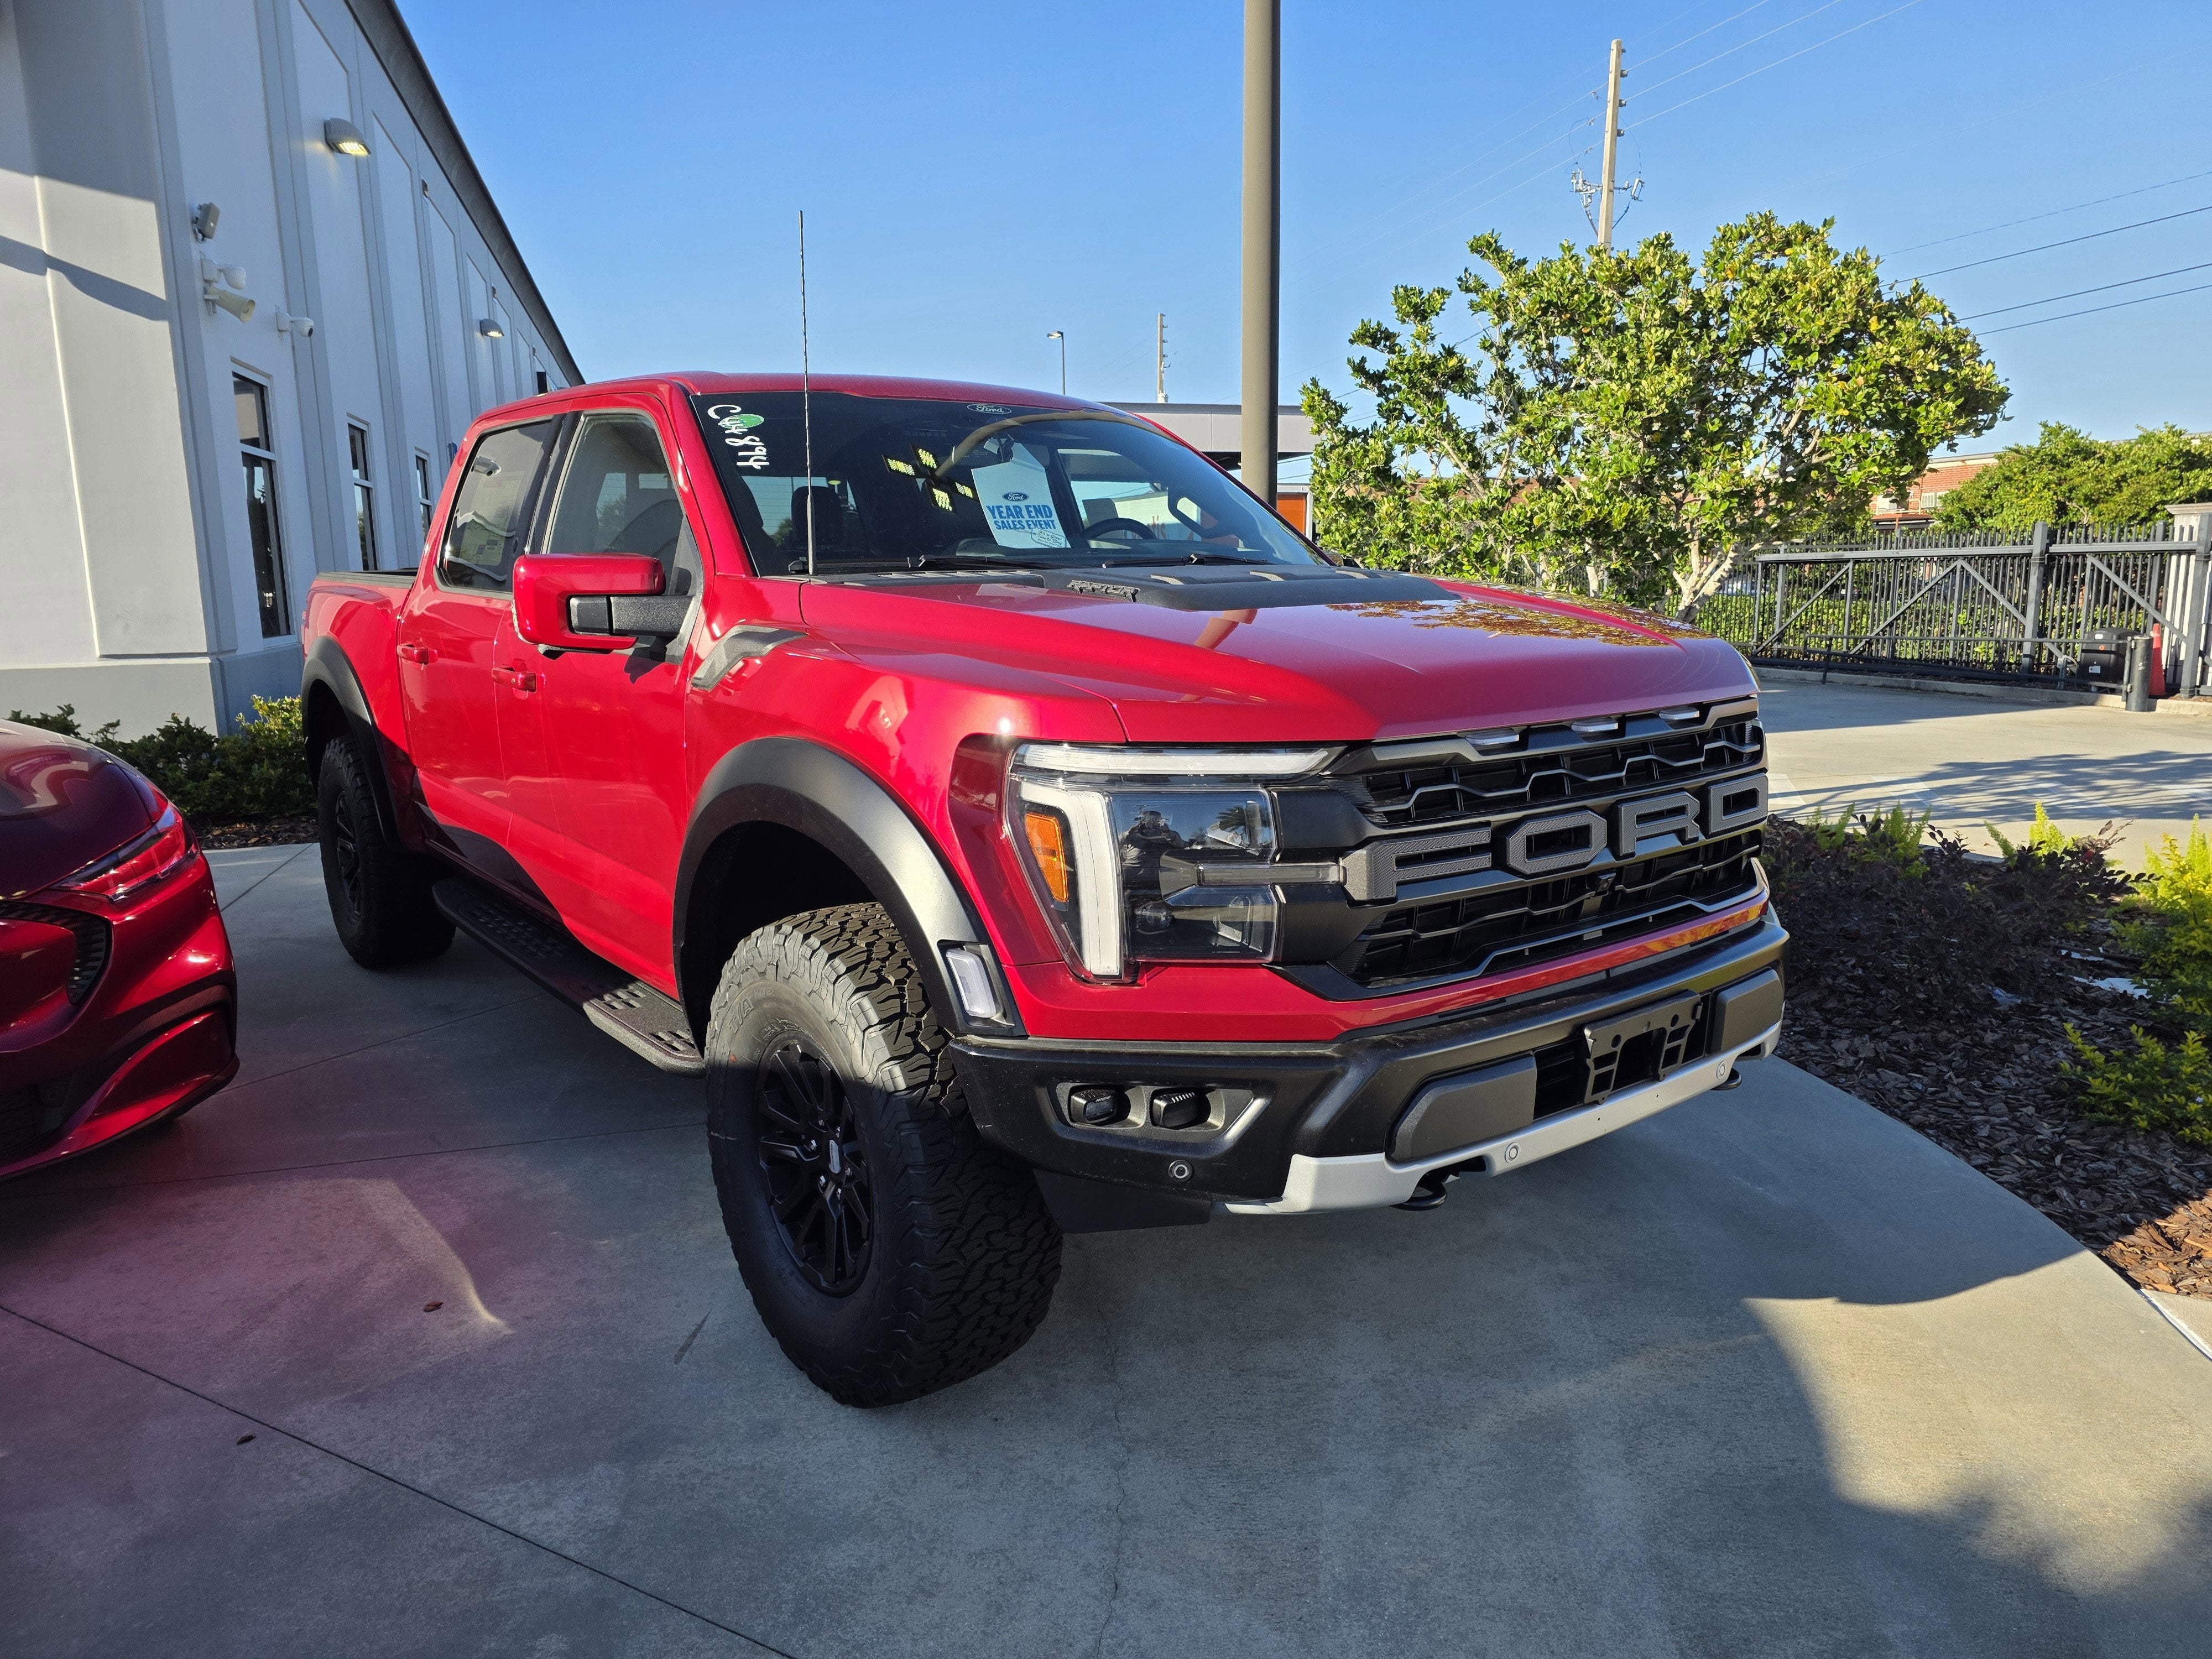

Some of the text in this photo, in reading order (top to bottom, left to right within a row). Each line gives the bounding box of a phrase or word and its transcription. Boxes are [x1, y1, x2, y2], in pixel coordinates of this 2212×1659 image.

[976, 405, 1005, 413] Ford
[986, 504, 1053, 519] YEAR END
[994, 520, 1056, 530] SALES EVENT
[1067, 580, 1140, 602] RAPTOR
[1358, 775, 1768, 901] FORD
